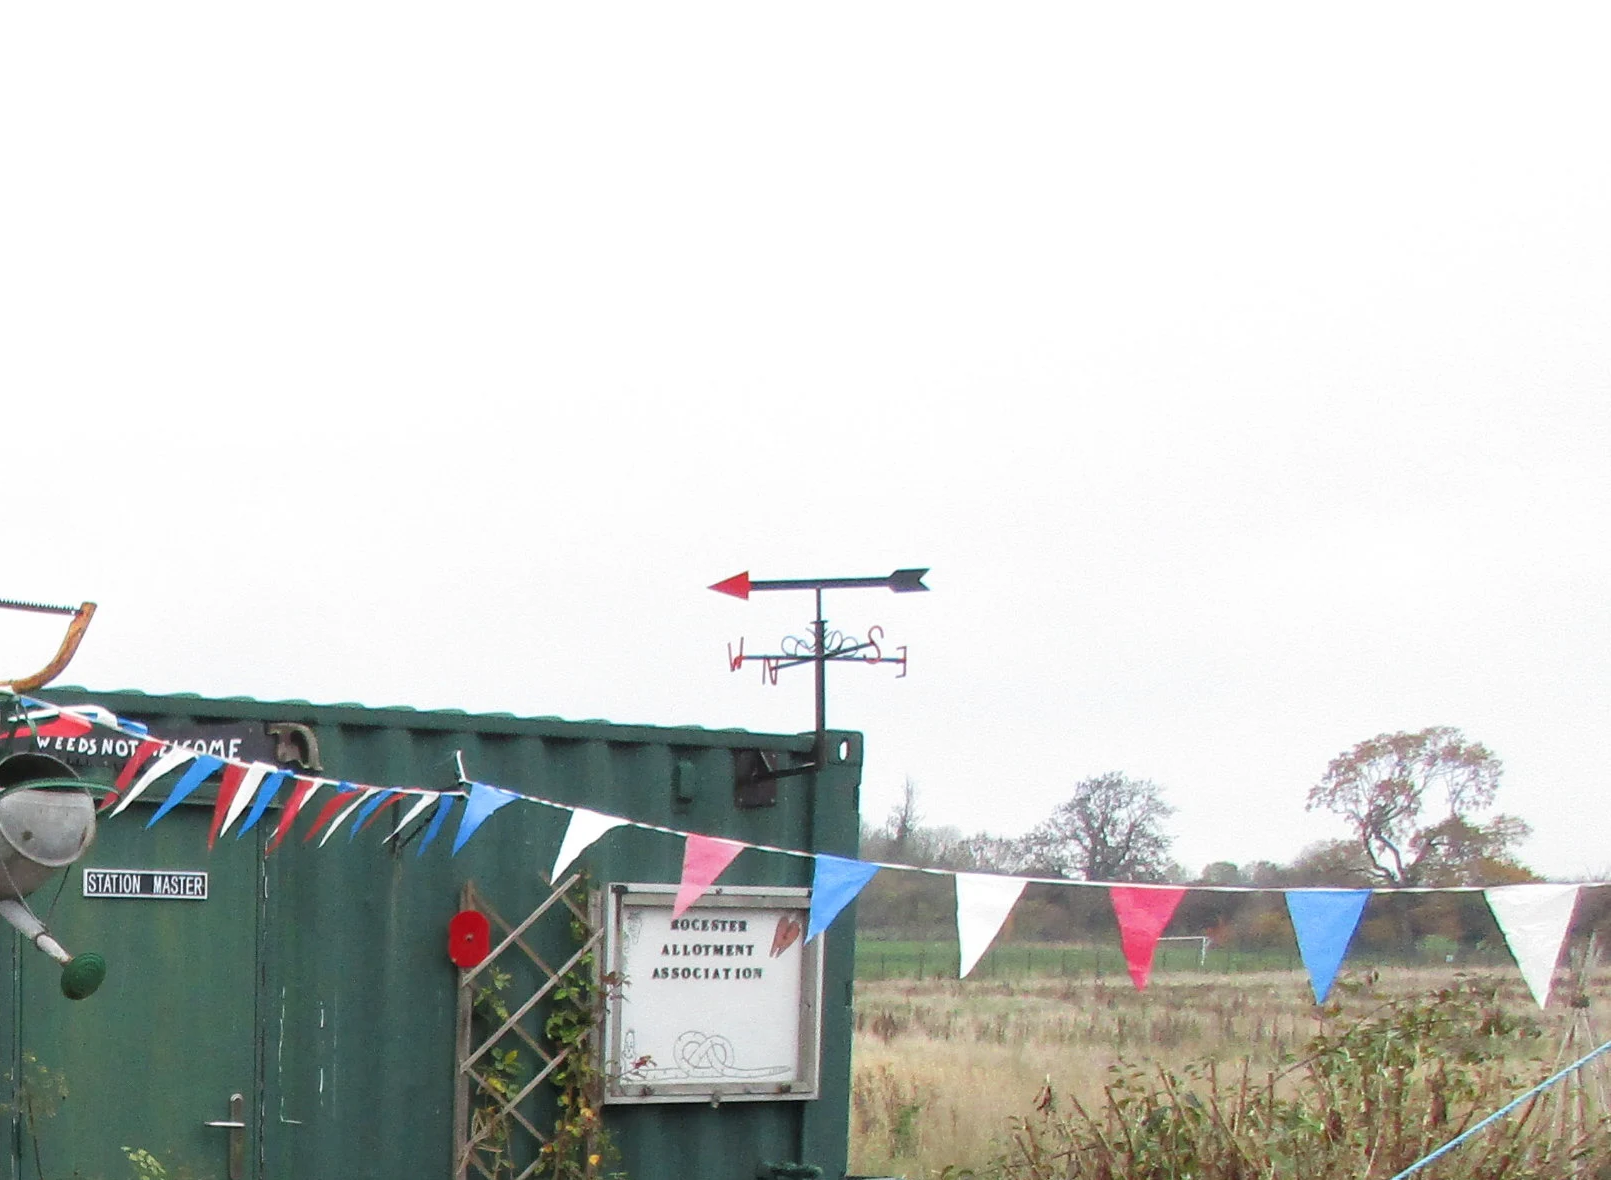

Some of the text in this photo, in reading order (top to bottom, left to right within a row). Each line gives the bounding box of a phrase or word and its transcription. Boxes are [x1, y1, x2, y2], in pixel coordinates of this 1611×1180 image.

[863, 625, 884, 665] S
[36, 735, 243, 762] WEEDS NOT ECOME
[88, 873, 203, 896] STATION MASTER
[671, 919, 747, 932] ROCESTER
[661, 944, 754, 956] ALLOTMENT
[652, 968, 763, 980] ASSOCIATION
